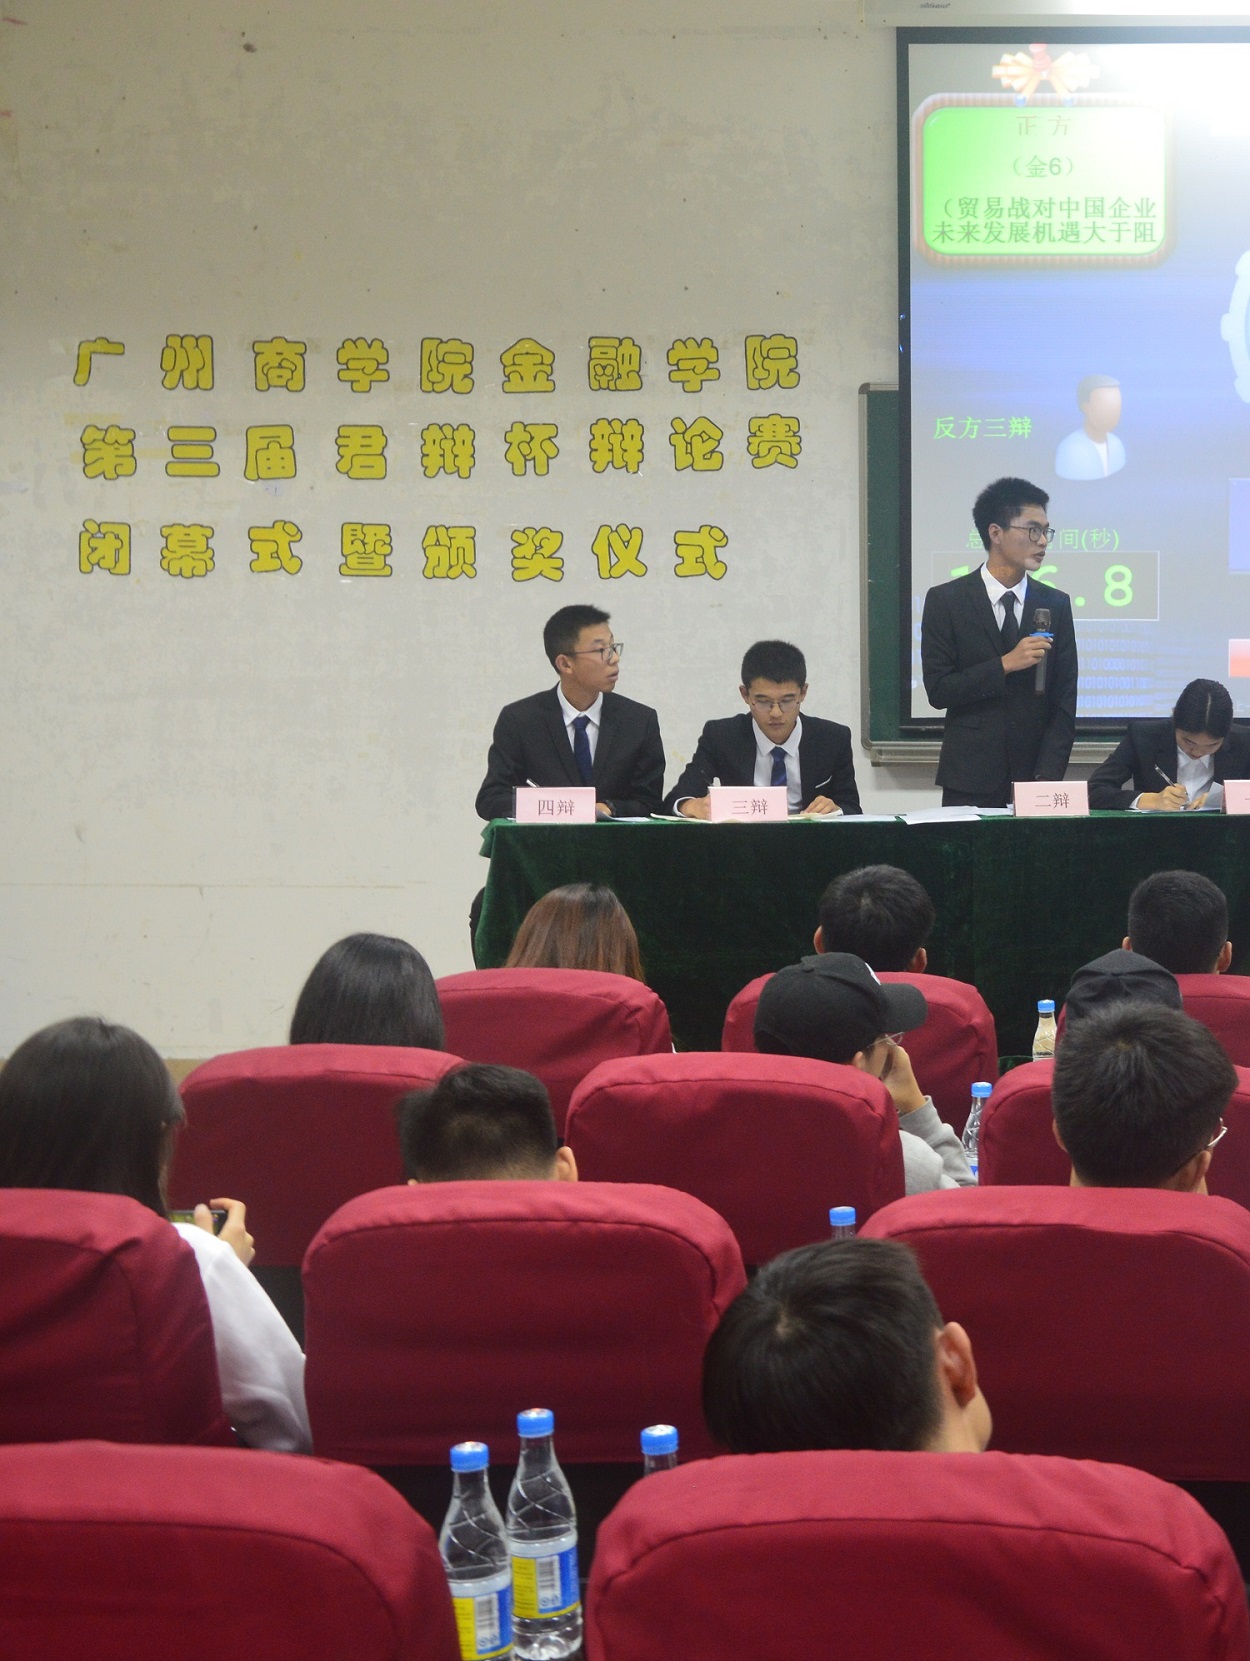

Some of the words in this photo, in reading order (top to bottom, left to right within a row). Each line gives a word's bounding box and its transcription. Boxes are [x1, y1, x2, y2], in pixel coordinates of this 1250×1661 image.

[932, 221, 1158, 244] 未来发展机遇大于阻
[73, 333, 802, 395] 广州商学院金融学院
[932, 415, 1034, 440] 反方三辩
[79, 413, 803, 481] 第三届君辩杯辩论赛
[78, 519, 730, 583] 闭幕式暨颁奖仪式
[537, 798, 576, 817] 四辩
[731, 798, 769, 817] 三辩
[1034, 791, 1070, 809] 二辩
